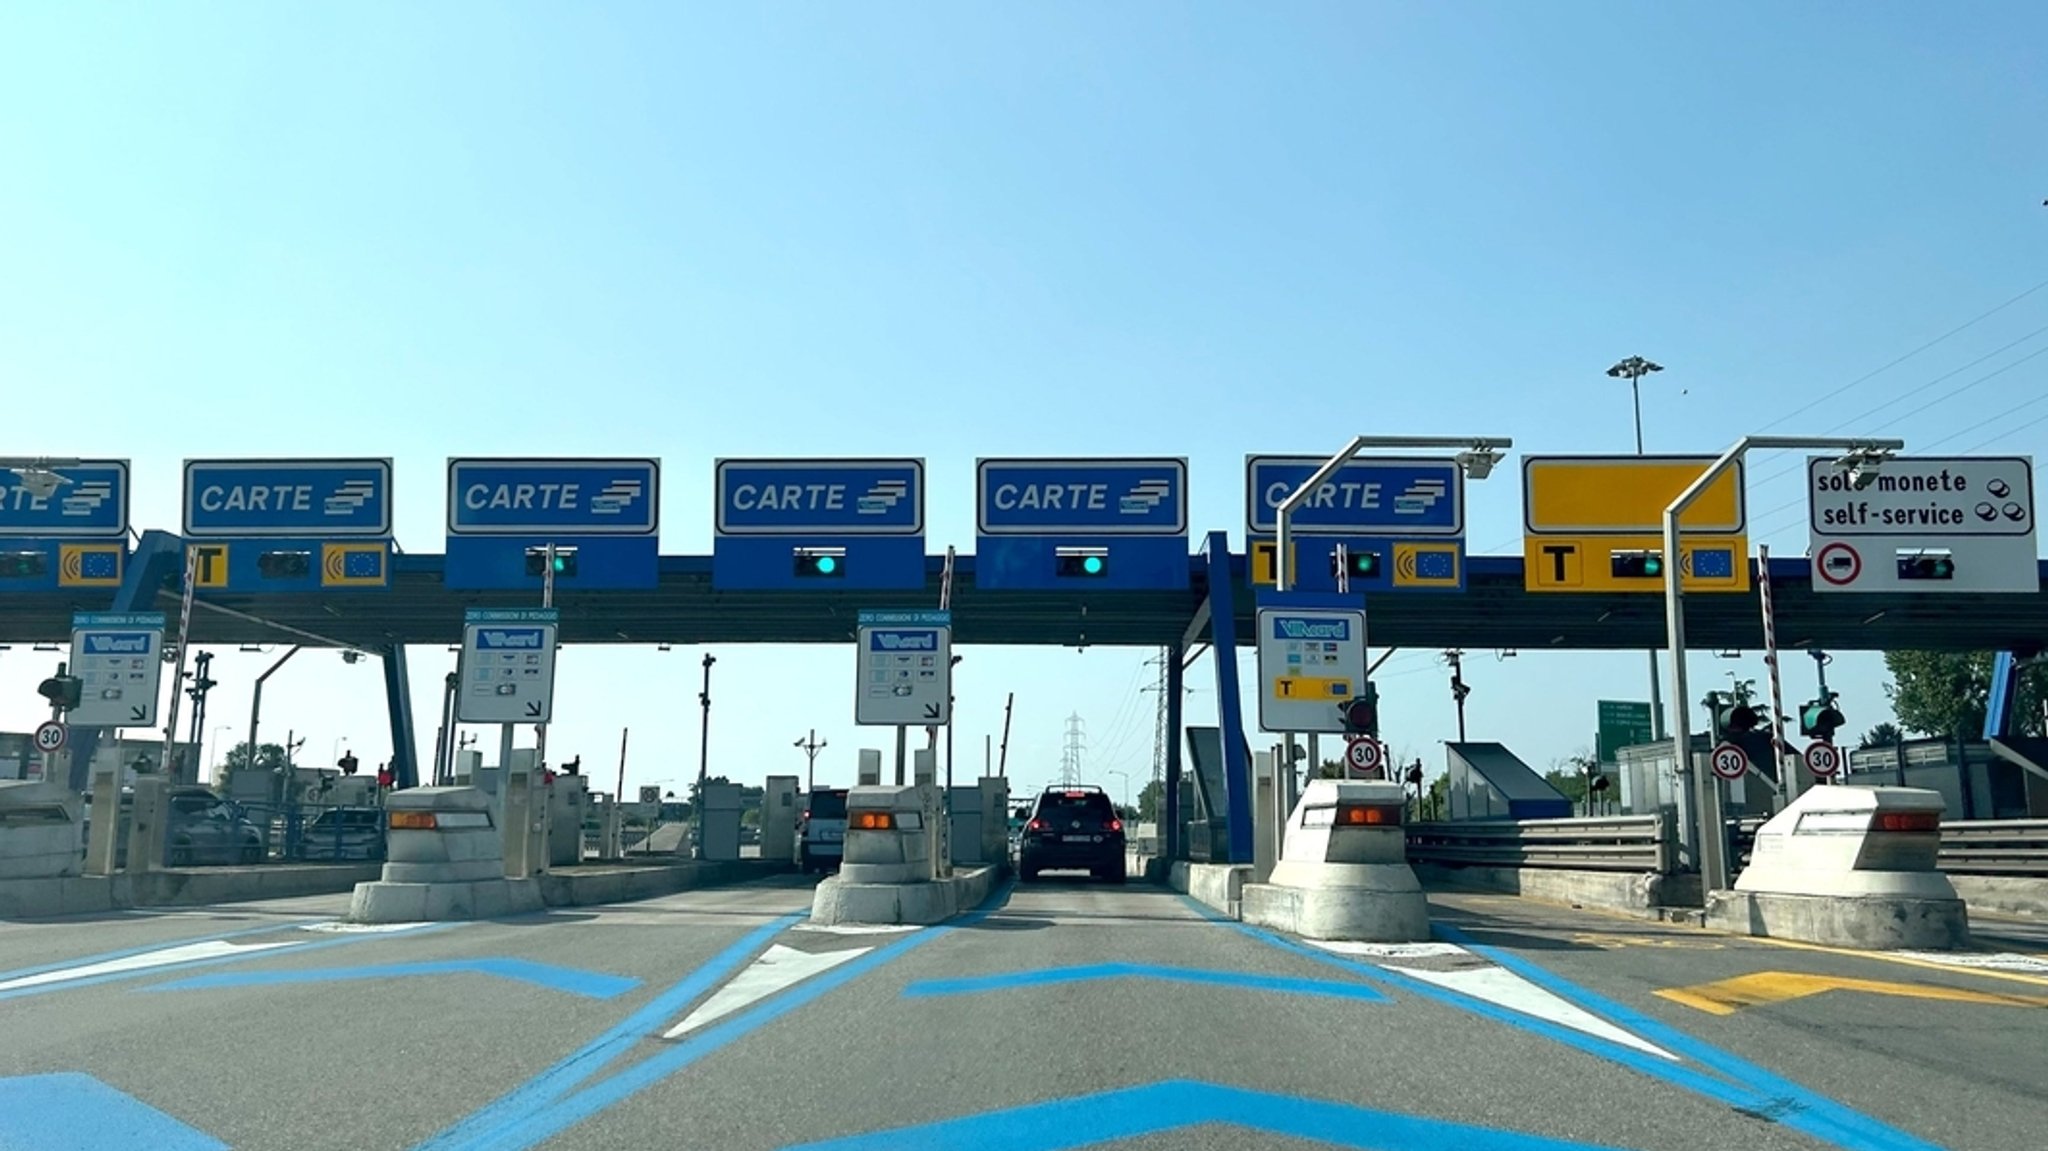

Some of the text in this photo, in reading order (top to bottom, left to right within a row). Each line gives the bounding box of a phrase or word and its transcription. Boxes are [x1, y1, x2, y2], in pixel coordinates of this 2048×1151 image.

[1878, 469, 1967, 491] monete
[200, 485, 313, 512] CARTE
[465, 483, 580, 509] CARTE
[733, 484, 846, 511] CARTE
[994, 484, 1108, 510] CARTE
[1824, 501, 1964, 524] self-service
[198, 548, 222, 583] T
[1543, 545, 1575, 581] T
[1280, 680, 1292, 695] T
[42, 729, 60, 744] 30
[1355, 746, 1374, 762] 30
[1720, 754, 1740, 770] 30
[1812, 751, 1832, 767] 30
